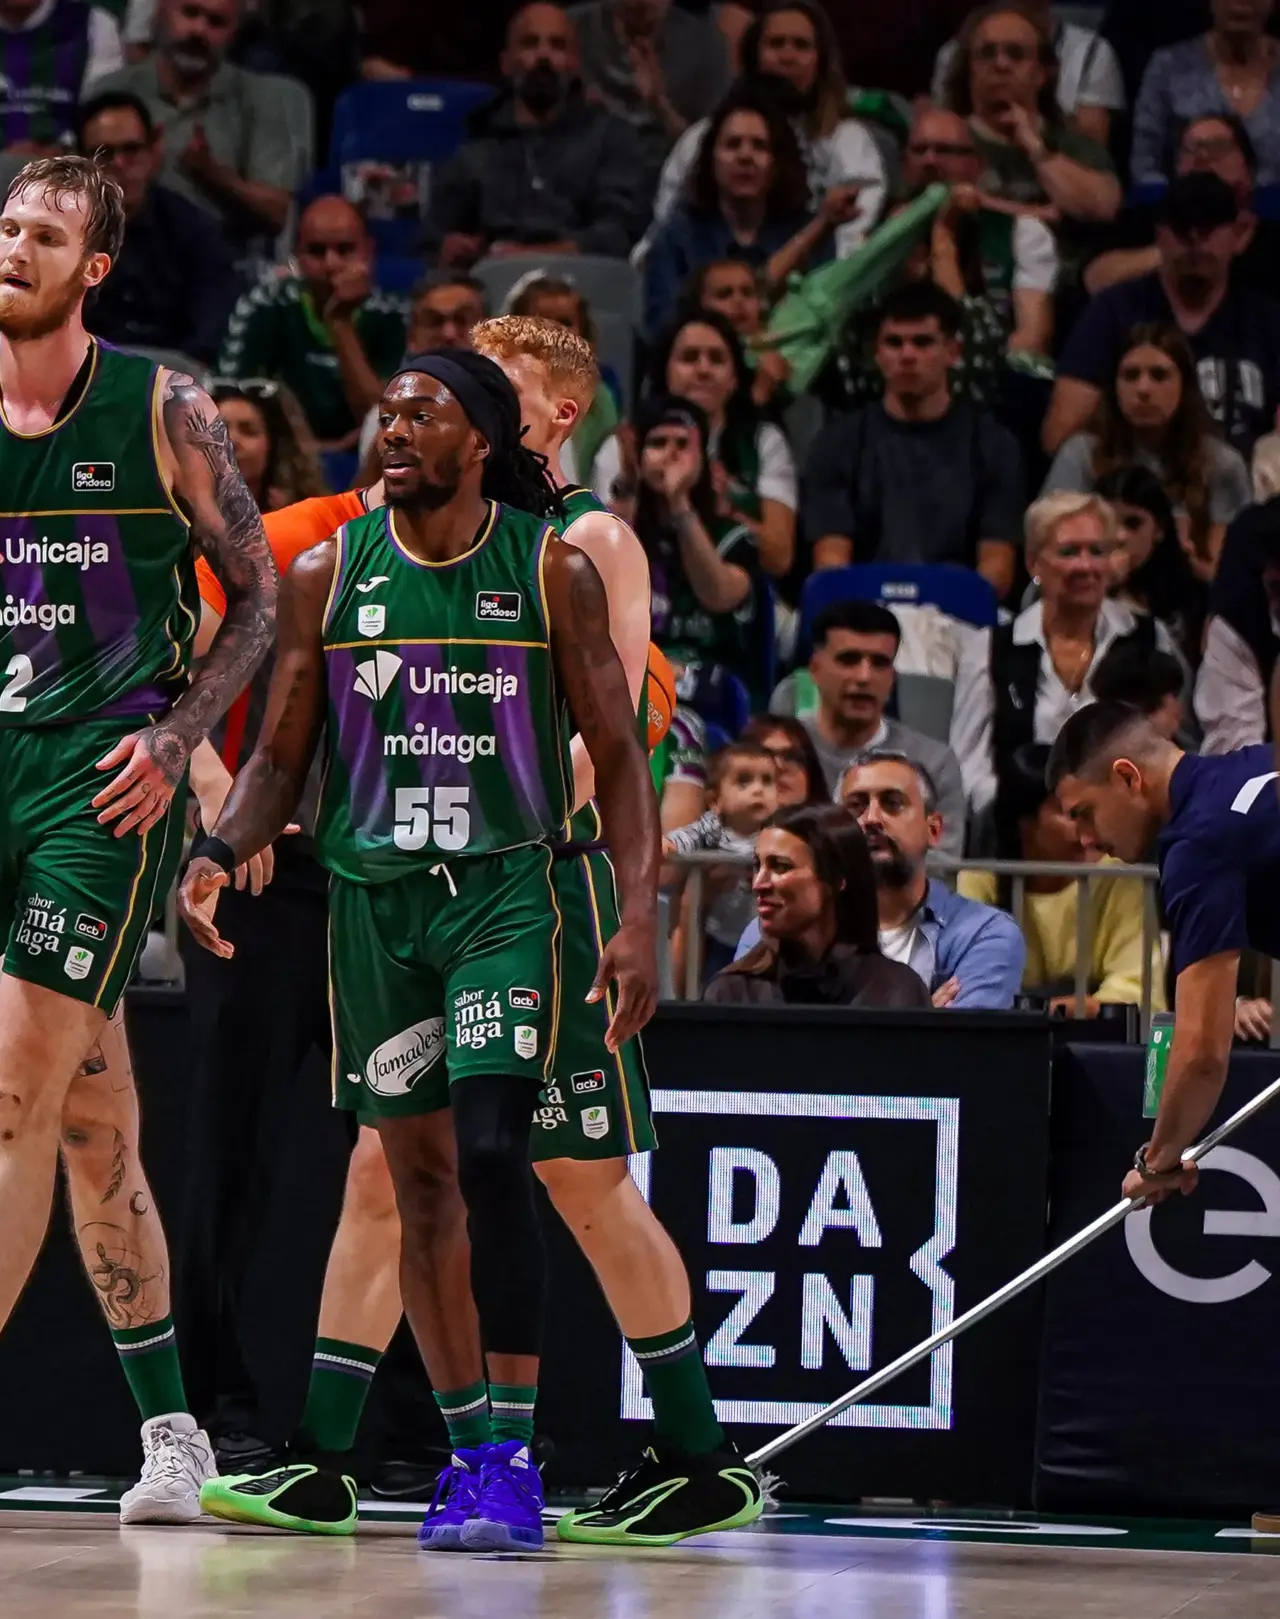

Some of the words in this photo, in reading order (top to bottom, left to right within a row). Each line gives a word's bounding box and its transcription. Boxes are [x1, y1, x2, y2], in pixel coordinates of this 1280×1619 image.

[5, 536, 109, 571] Unicaja
[480, 600, 498, 609] liga
[480, 608, 517, 617] endesa
[409, 666, 518, 703] Unicaja
[393, 787, 470, 851] 55
[15, 920, 60, 956] laga
[78, 922, 100, 936] acb
[454, 989, 485, 1009] sabor
[512, 996, 534, 1007] acb
[456, 1021, 504, 1049] laga
[546, 1078, 566, 1104] á
[576, 1079, 598, 1091] acb
